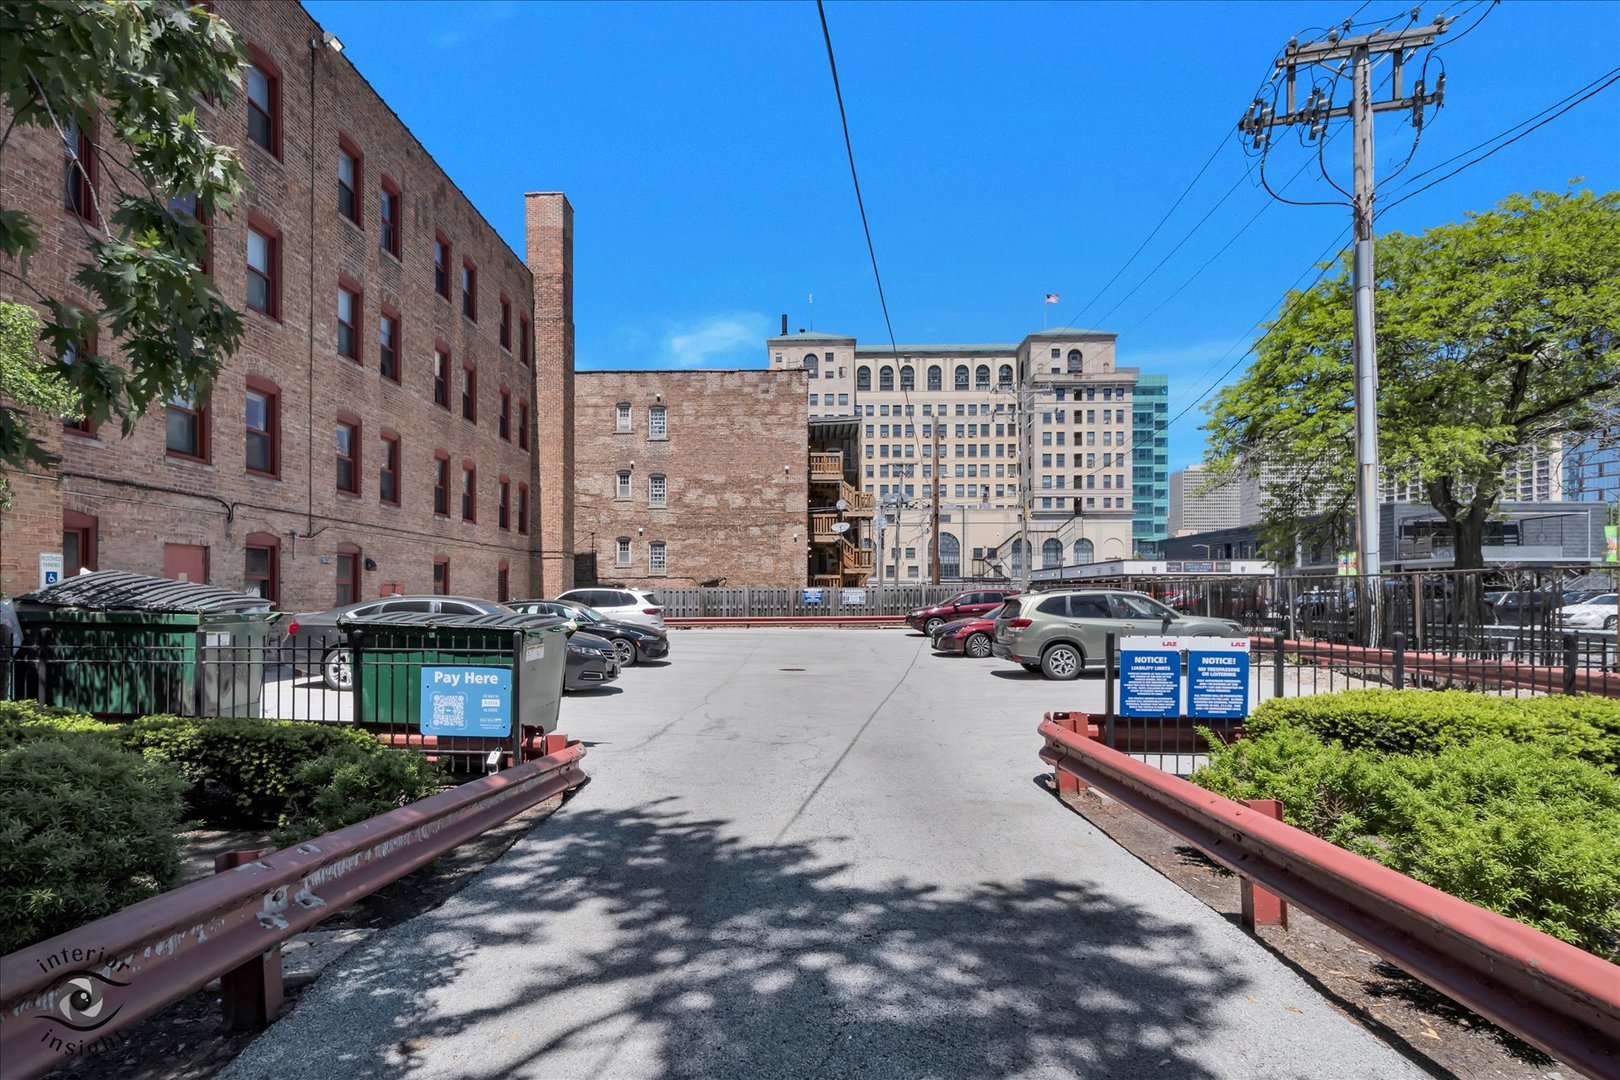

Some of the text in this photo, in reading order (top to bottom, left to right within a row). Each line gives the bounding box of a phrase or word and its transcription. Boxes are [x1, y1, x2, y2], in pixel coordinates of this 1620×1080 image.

[1202, 657, 1236, 665] NOTICE!
[434, 671, 499, 686] Pay Here
